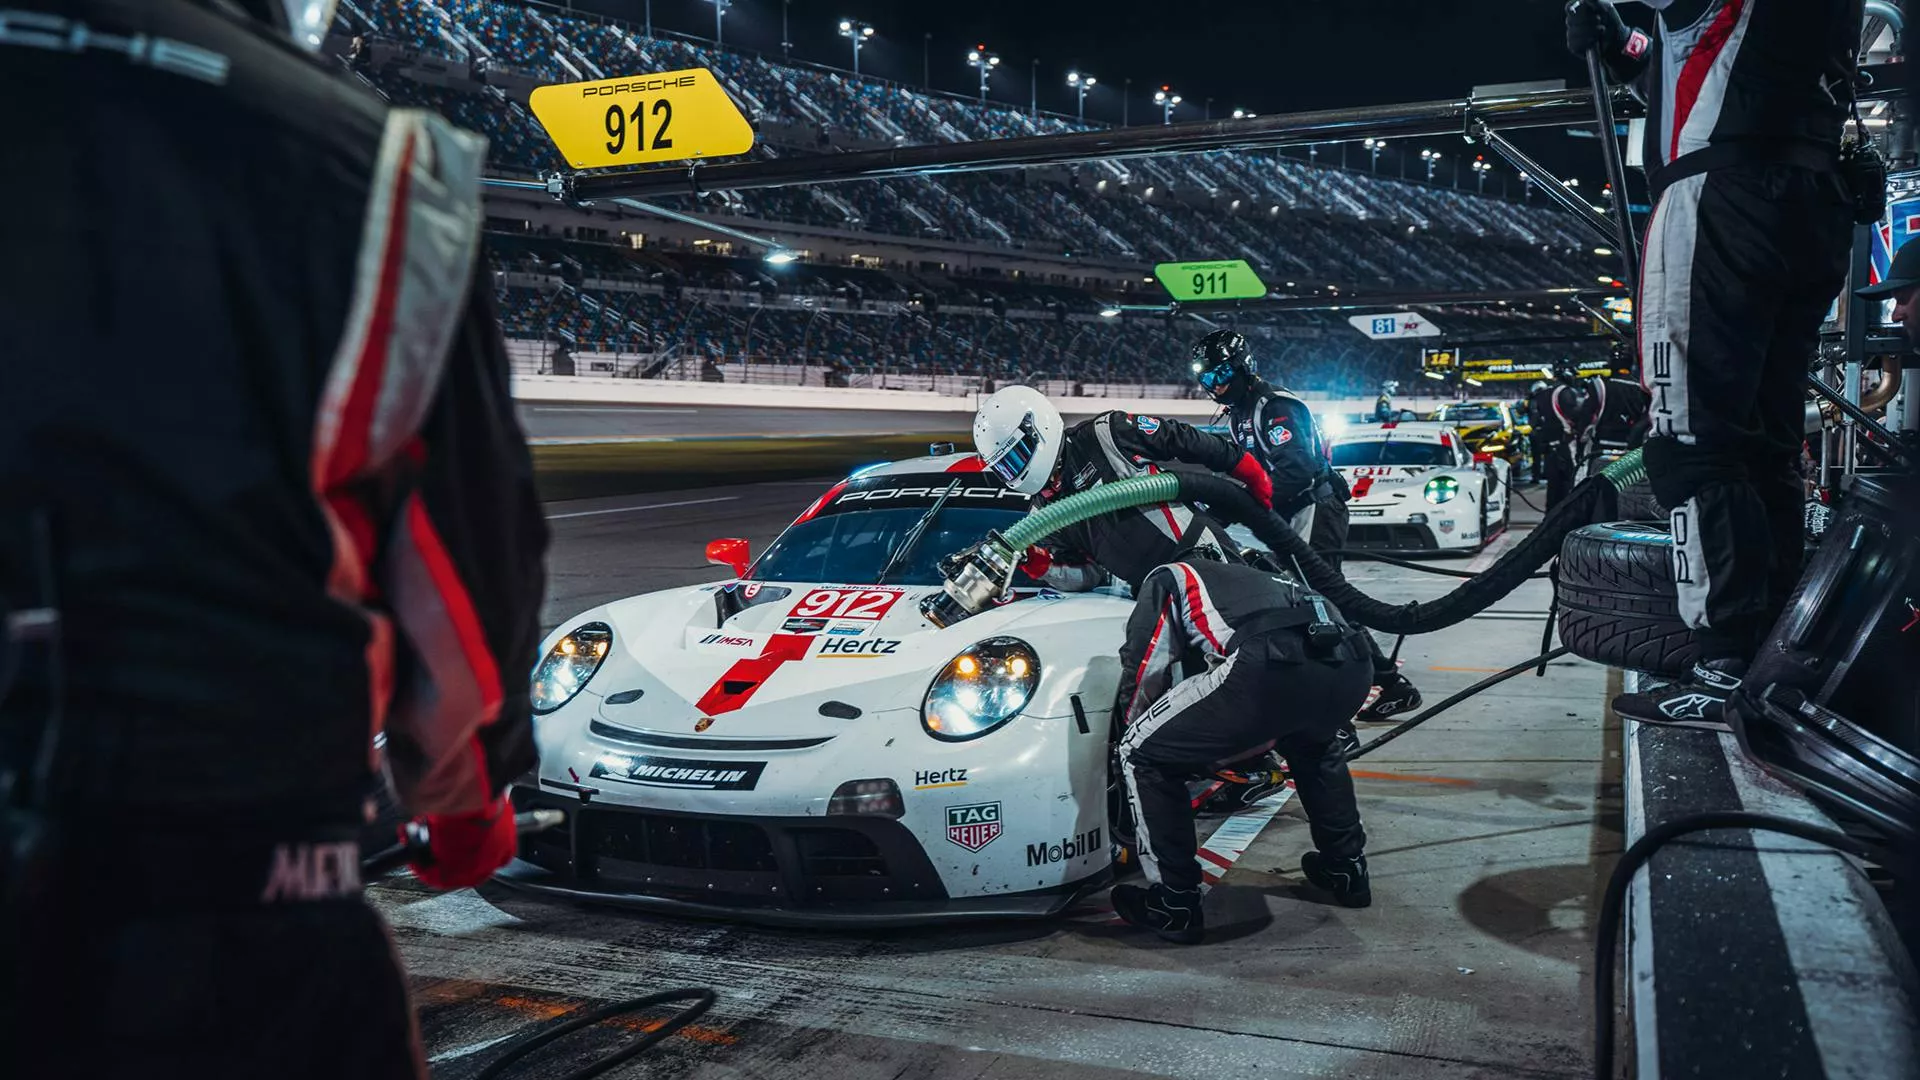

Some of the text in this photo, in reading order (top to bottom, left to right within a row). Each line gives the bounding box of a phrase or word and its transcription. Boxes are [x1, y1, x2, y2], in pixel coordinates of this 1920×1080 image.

[583, 75, 696, 98] PORSCHE
[605, 98, 673, 155] 912
[1193, 271, 1227, 295] 911
[1375, 319, 1393, 334] 81
[1430, 353, 1450, 365] 12
[835, 487, 1031, 504] PORSCH
[748, 583, 758, 595] E
[797, 590, 895, 618] 912
[819, 637, 902, 655] Hertz
[634, 765, 747, 782] MICHELIN
[915, 768, 967, 785] Hertz
[951, 806, 997, 824] TAG
[950, 823, 999, 849] HEUER
[1027, 832, 1085, 867] Mobil
